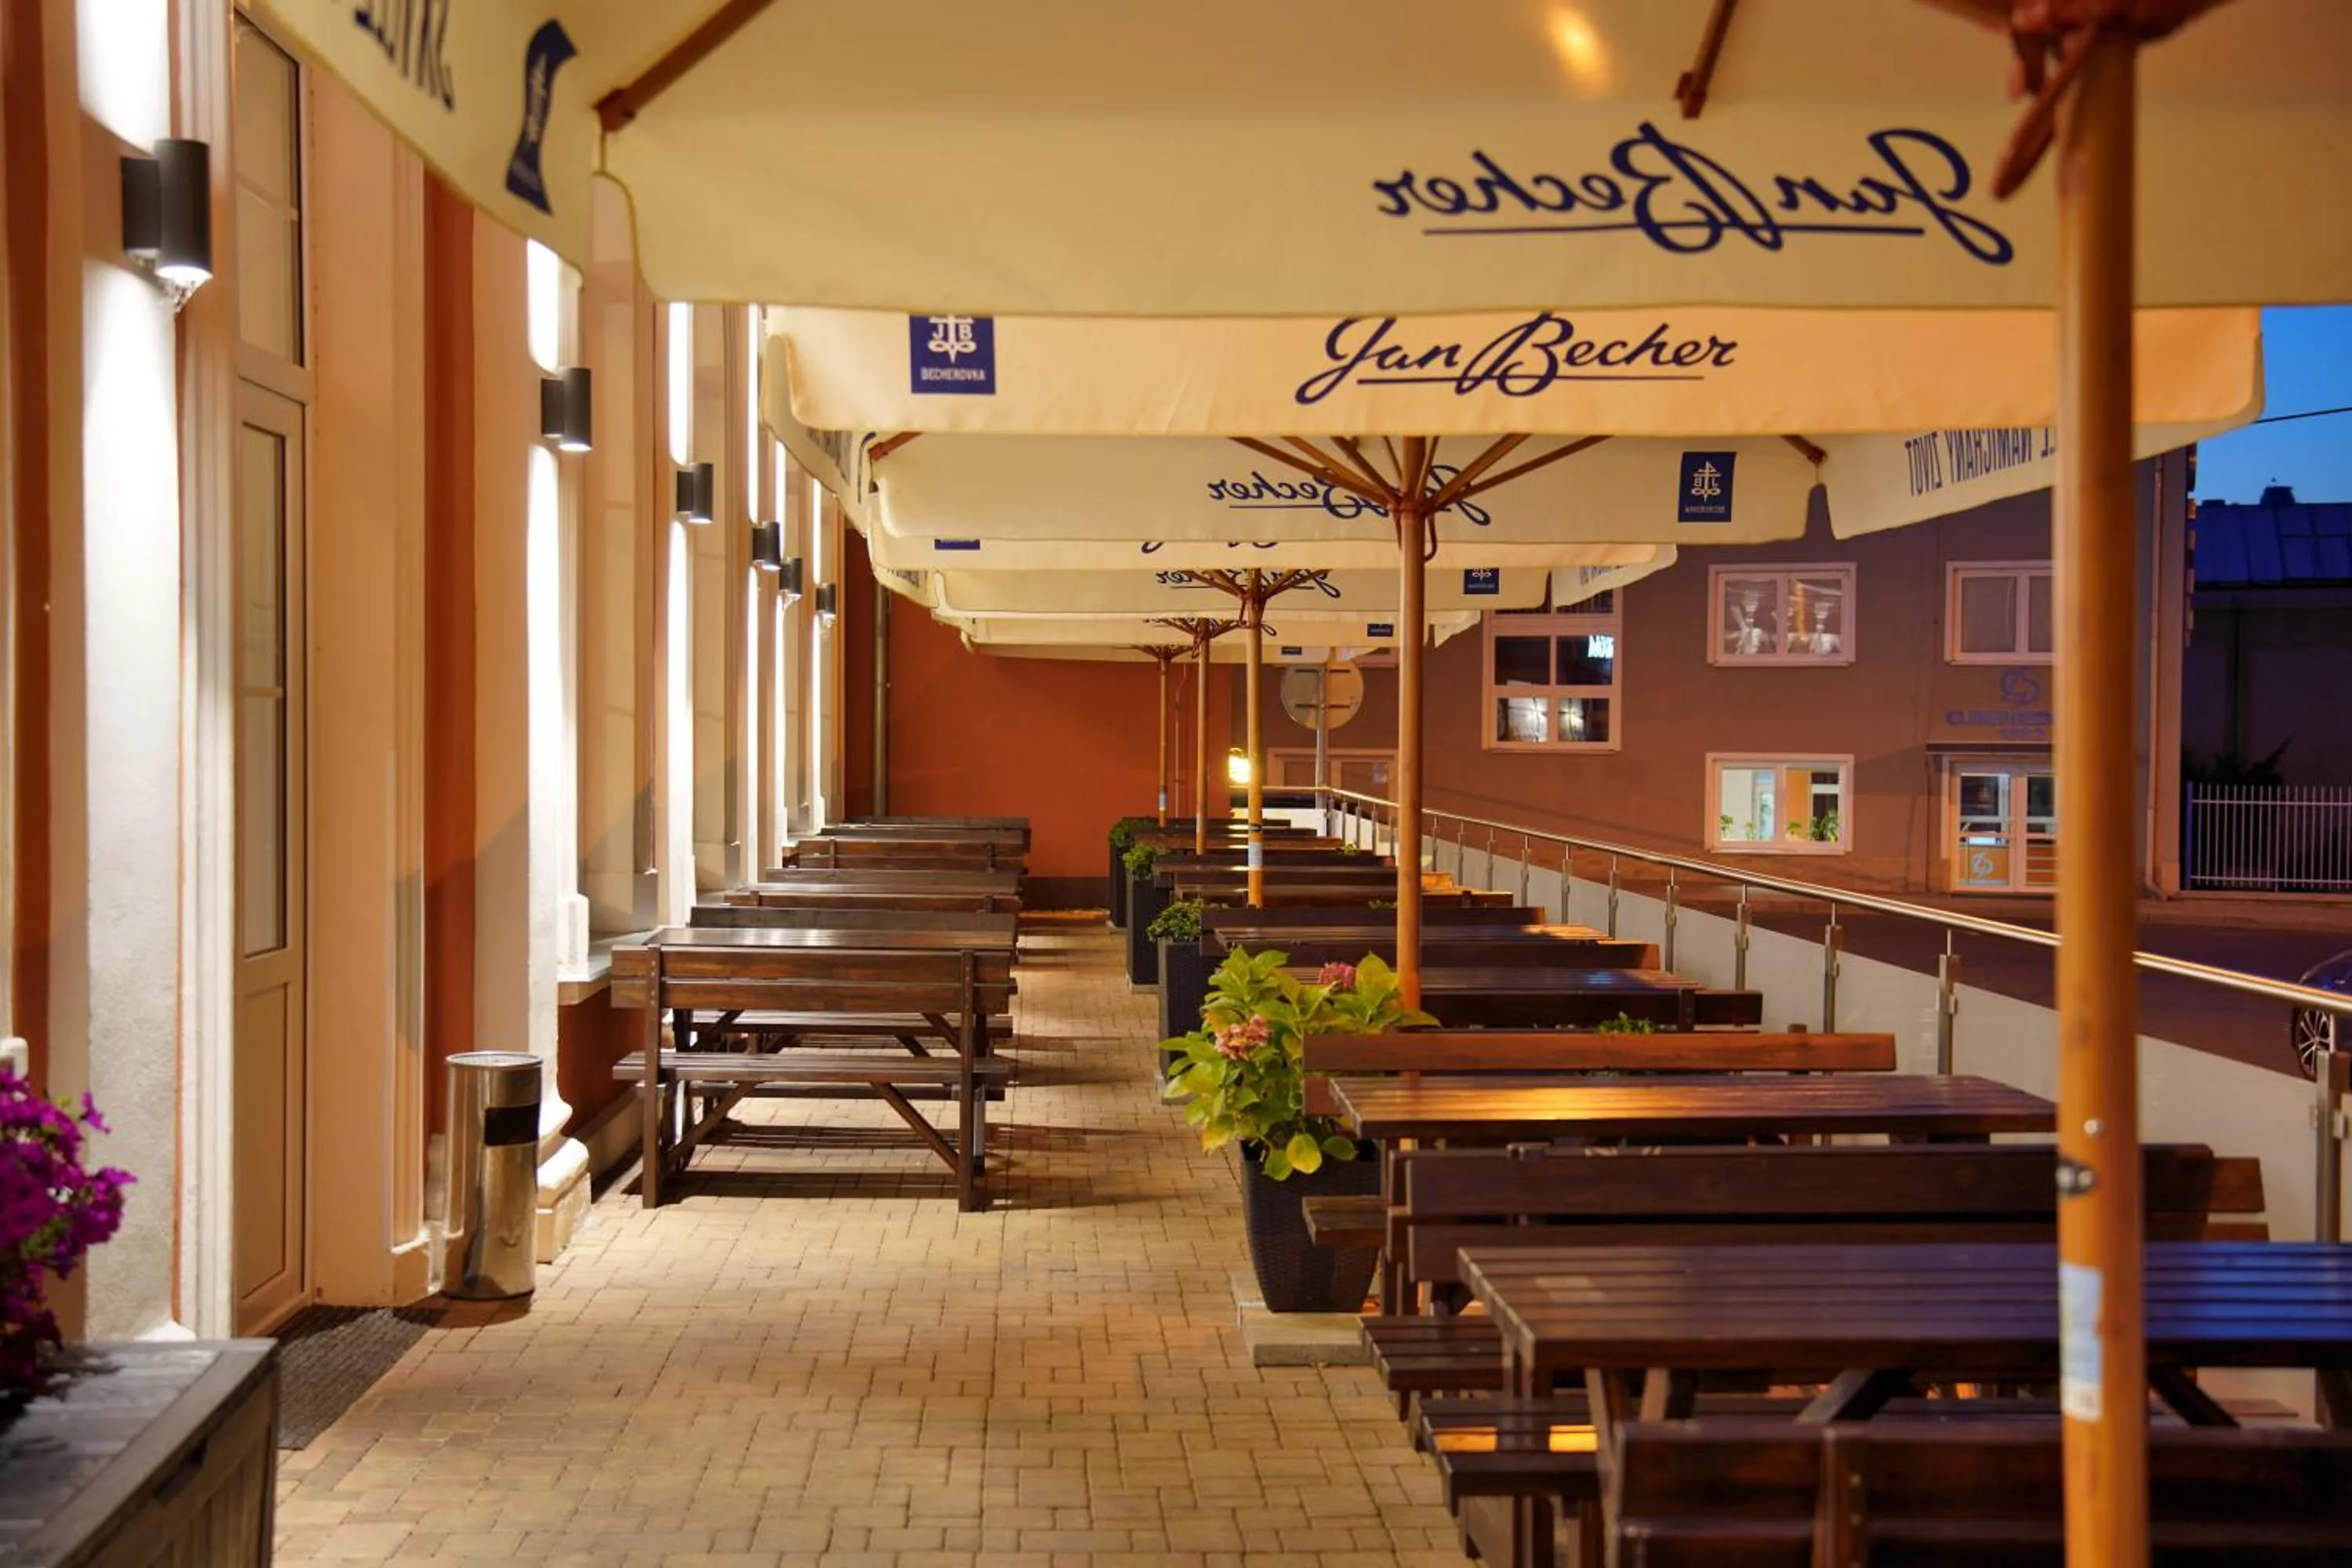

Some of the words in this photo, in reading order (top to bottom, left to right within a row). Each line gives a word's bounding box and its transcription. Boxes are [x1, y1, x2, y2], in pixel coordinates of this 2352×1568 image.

[920, 366, 986, 381] BECHEROVKA
[1298, 316, 1461, 405] Jan
[1454, 310, 1738, 397] Becher
